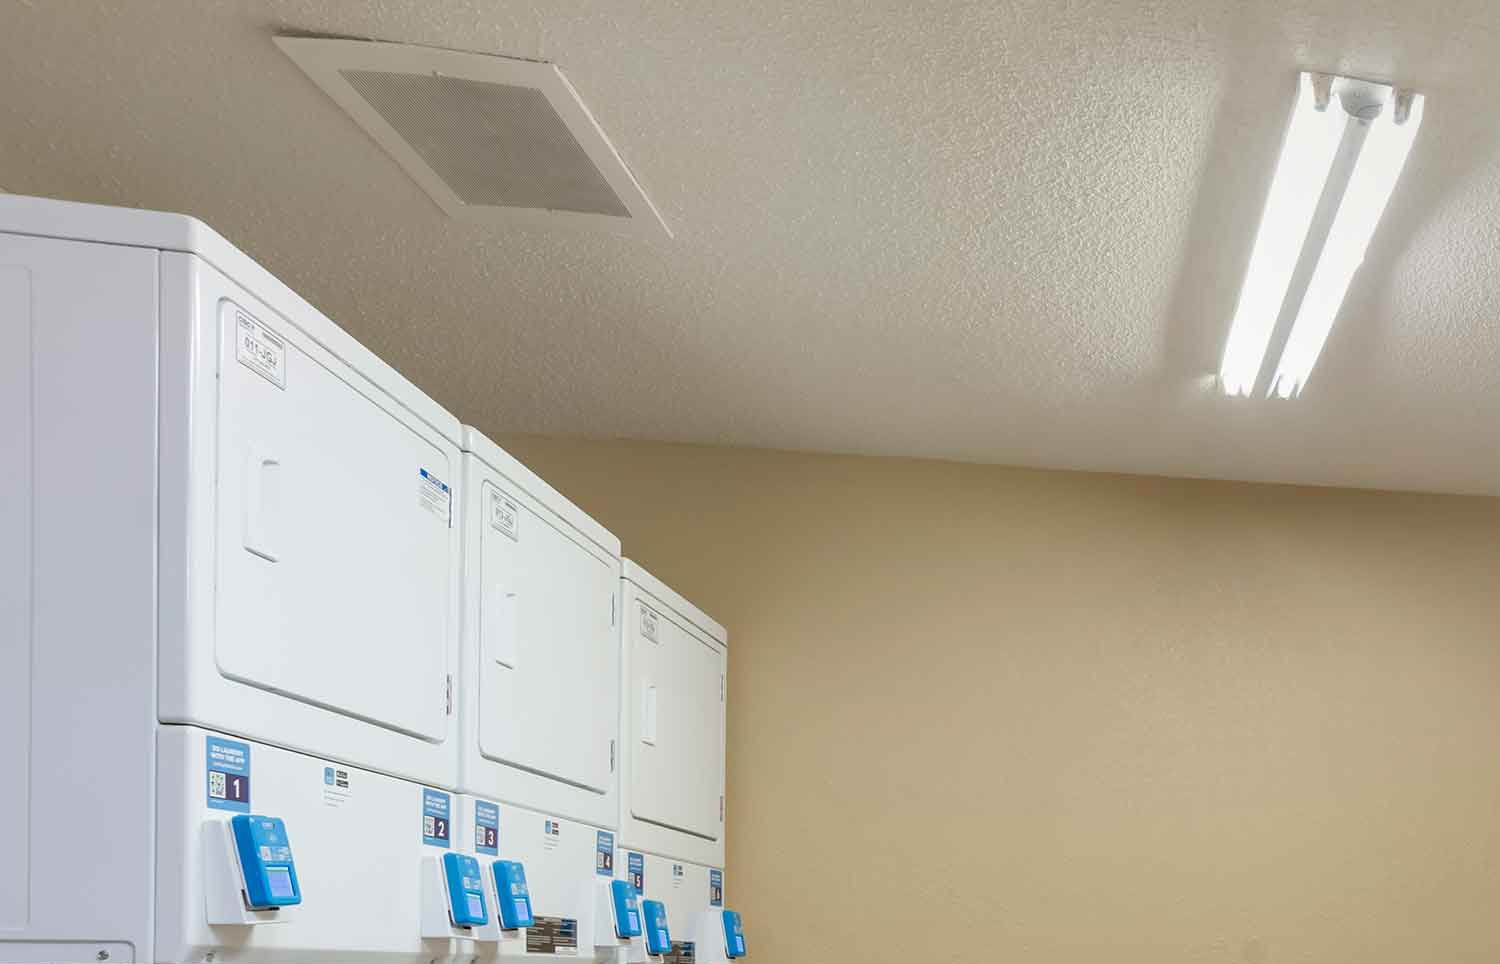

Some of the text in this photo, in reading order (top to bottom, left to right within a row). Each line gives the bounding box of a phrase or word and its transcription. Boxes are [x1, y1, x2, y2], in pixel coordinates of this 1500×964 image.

[233, 778, 240, 799] 1
[438, 820, 446, 837] 2
[488, 830, 495, 846] 3
